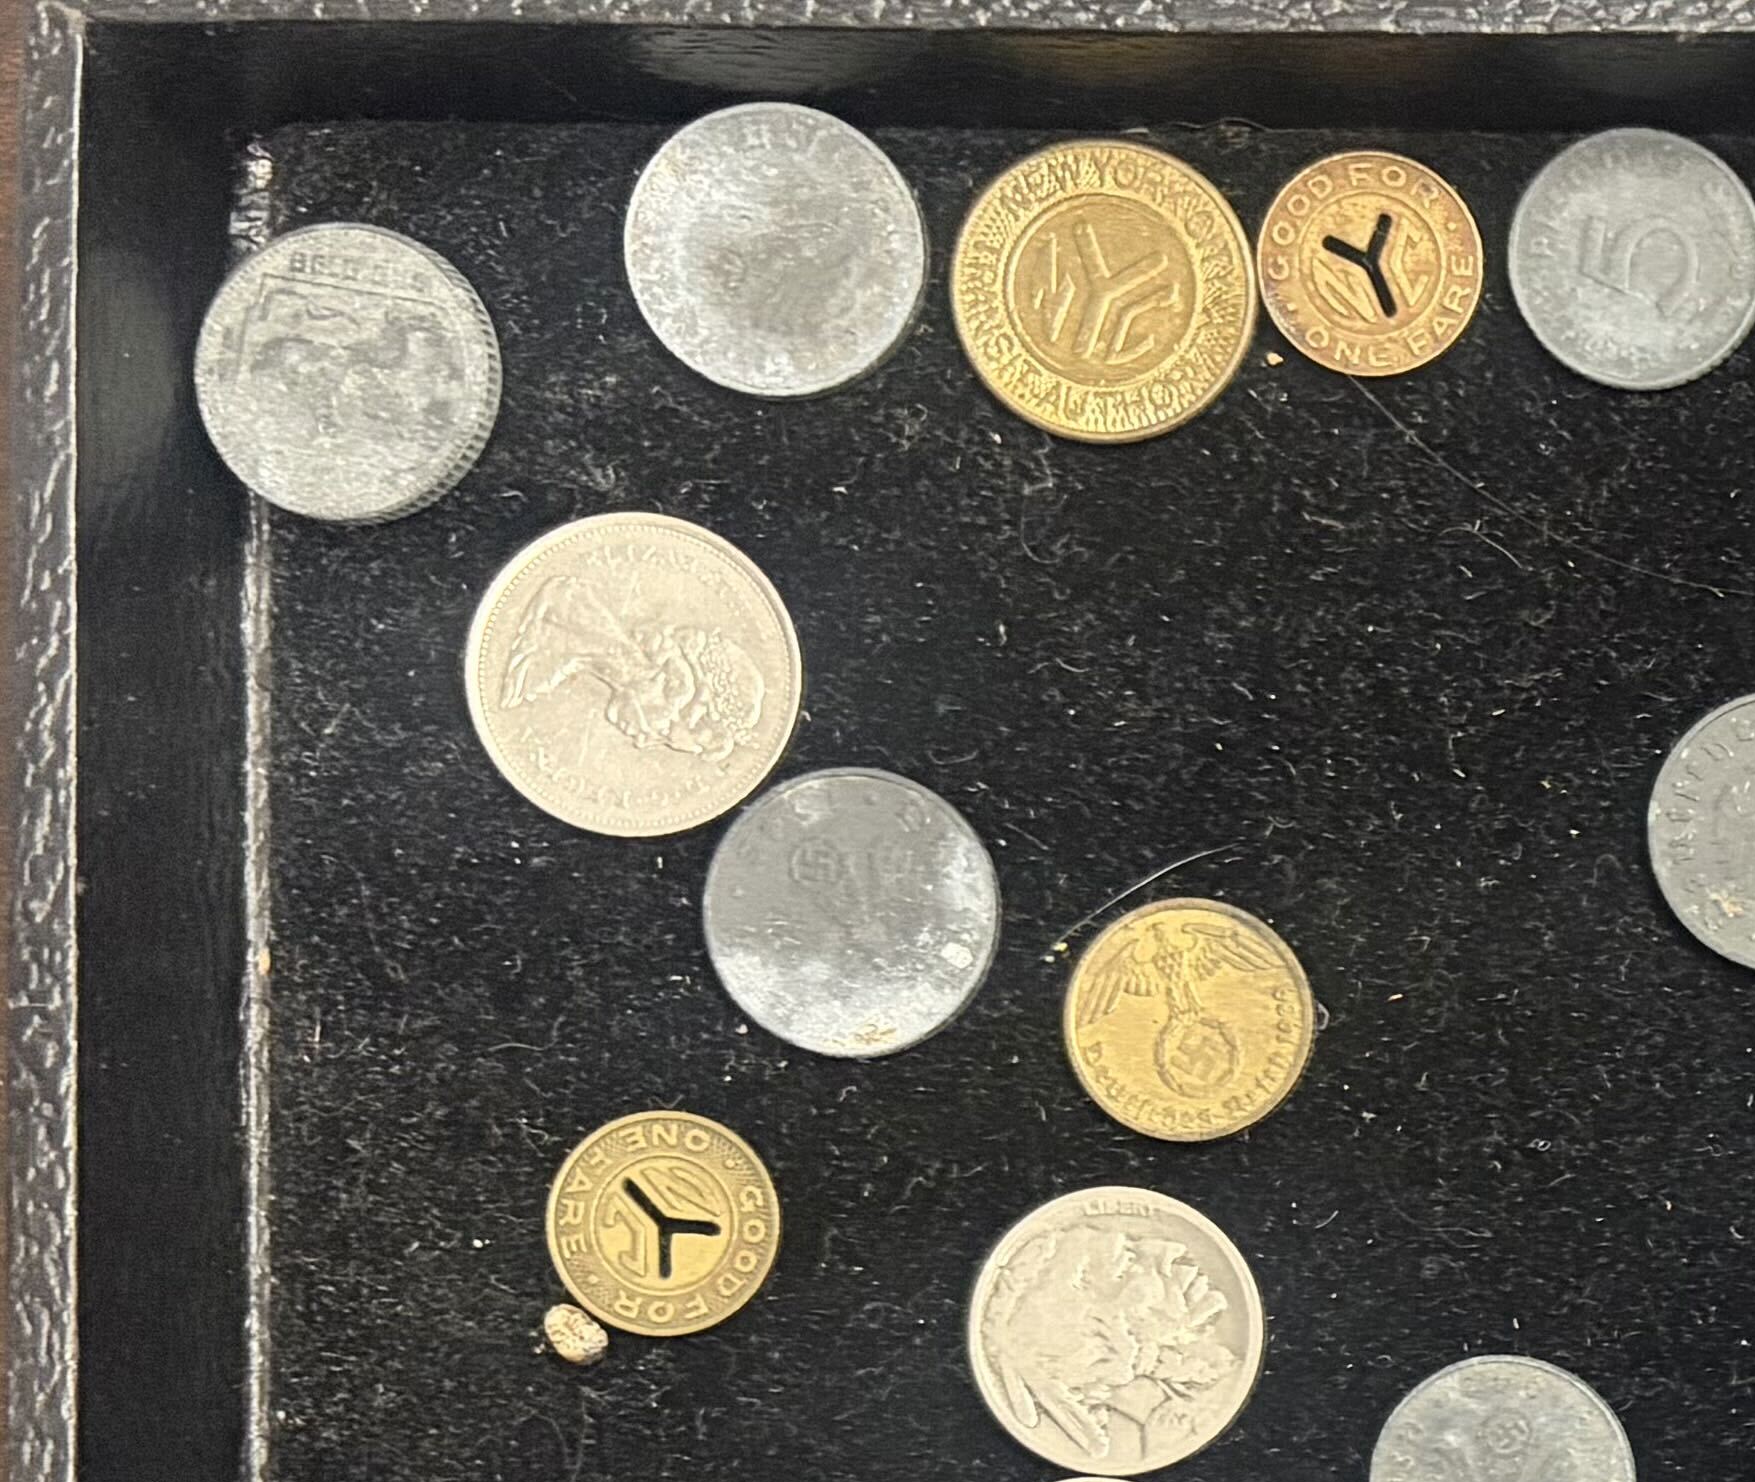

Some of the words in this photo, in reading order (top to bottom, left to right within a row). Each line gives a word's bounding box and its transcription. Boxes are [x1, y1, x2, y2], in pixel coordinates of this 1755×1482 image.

[1268, 174, 1333, 281] GOOD
[1347, 162, 1440, 209] FOR
[1305, 325, 1395, 368] ONE
[1407, 254, 1474, 357] FARE
[618, 1122, 712, 1153] ONE
[559, 1147, 614, 1260] FARE
[716, 1184, 768, 1298] GOOD
[612, 1290, 712, 1324] FOR
